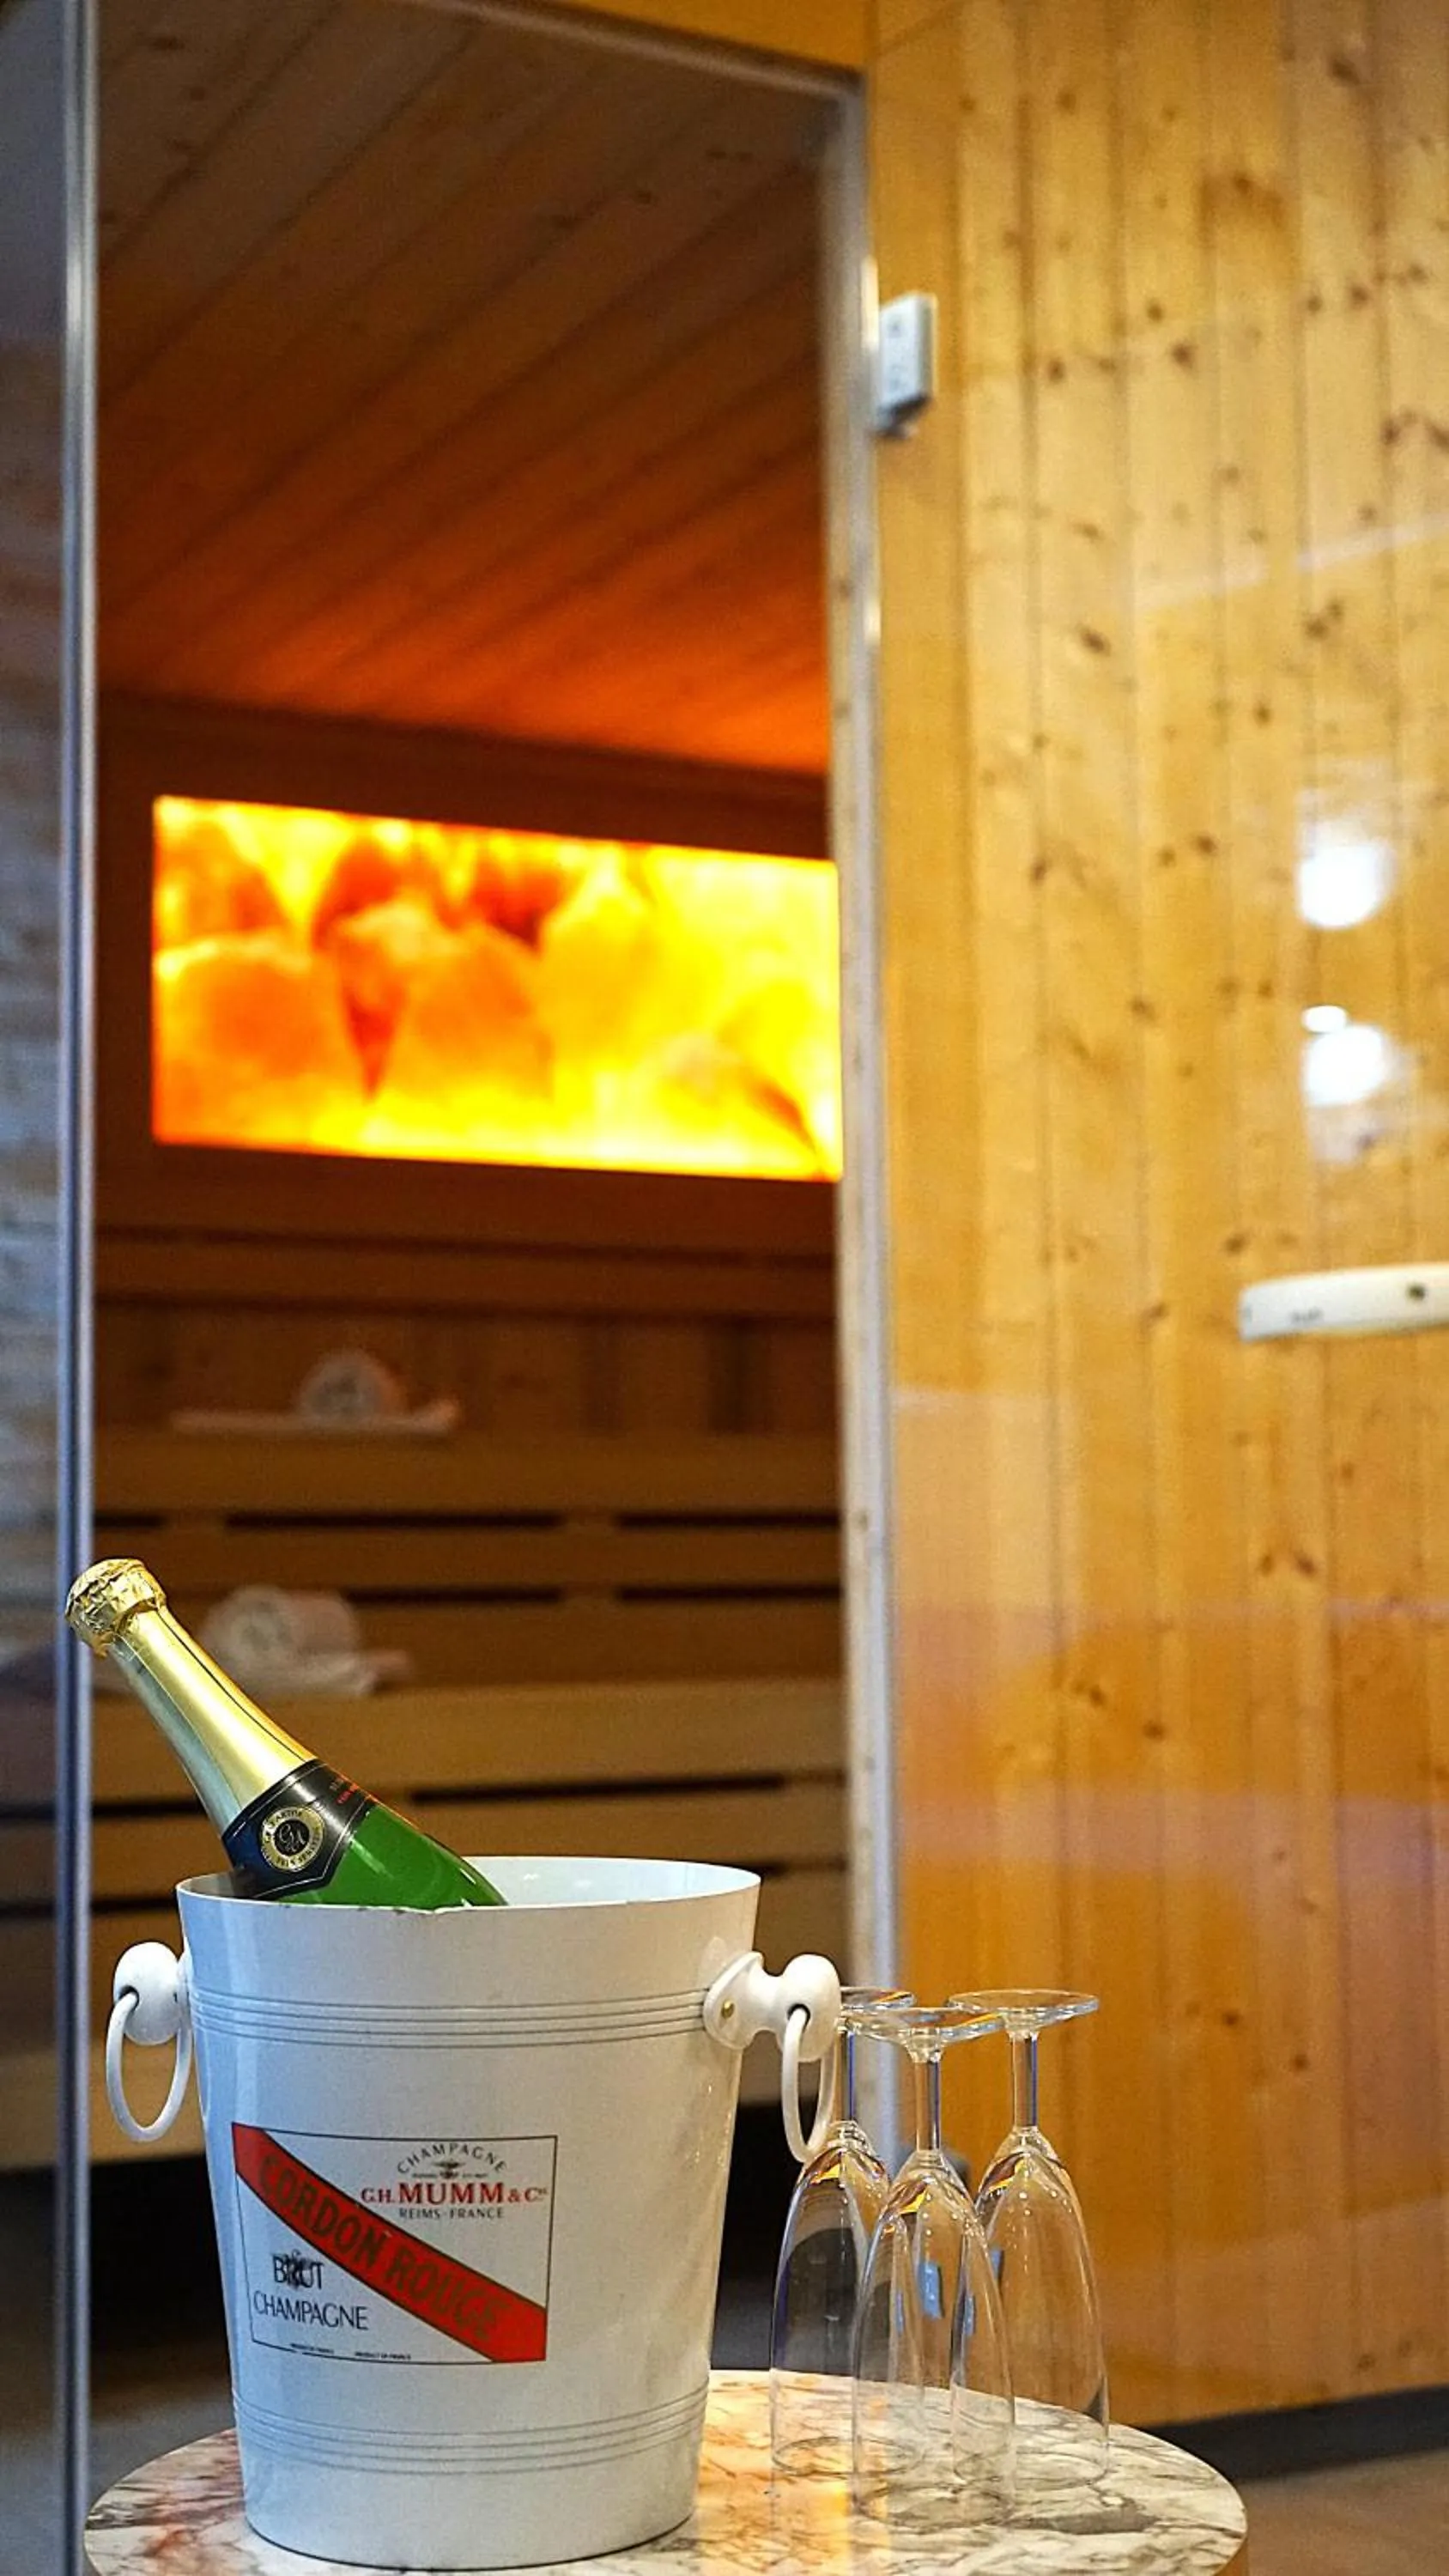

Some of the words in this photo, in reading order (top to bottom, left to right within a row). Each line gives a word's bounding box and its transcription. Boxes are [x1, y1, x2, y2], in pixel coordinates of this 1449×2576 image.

[397, 2142, 507, 2174] CHAMPAGNE
[398, 2181, 505, 2204] MUMM
[259, 2154, 388, 2269] CORDON
[385, 2245, 512, 2341] ROUGE
[273, 2252, 324, 2290] BRUT
[253, 2290, 368, 2330] CHAMPAGNE
